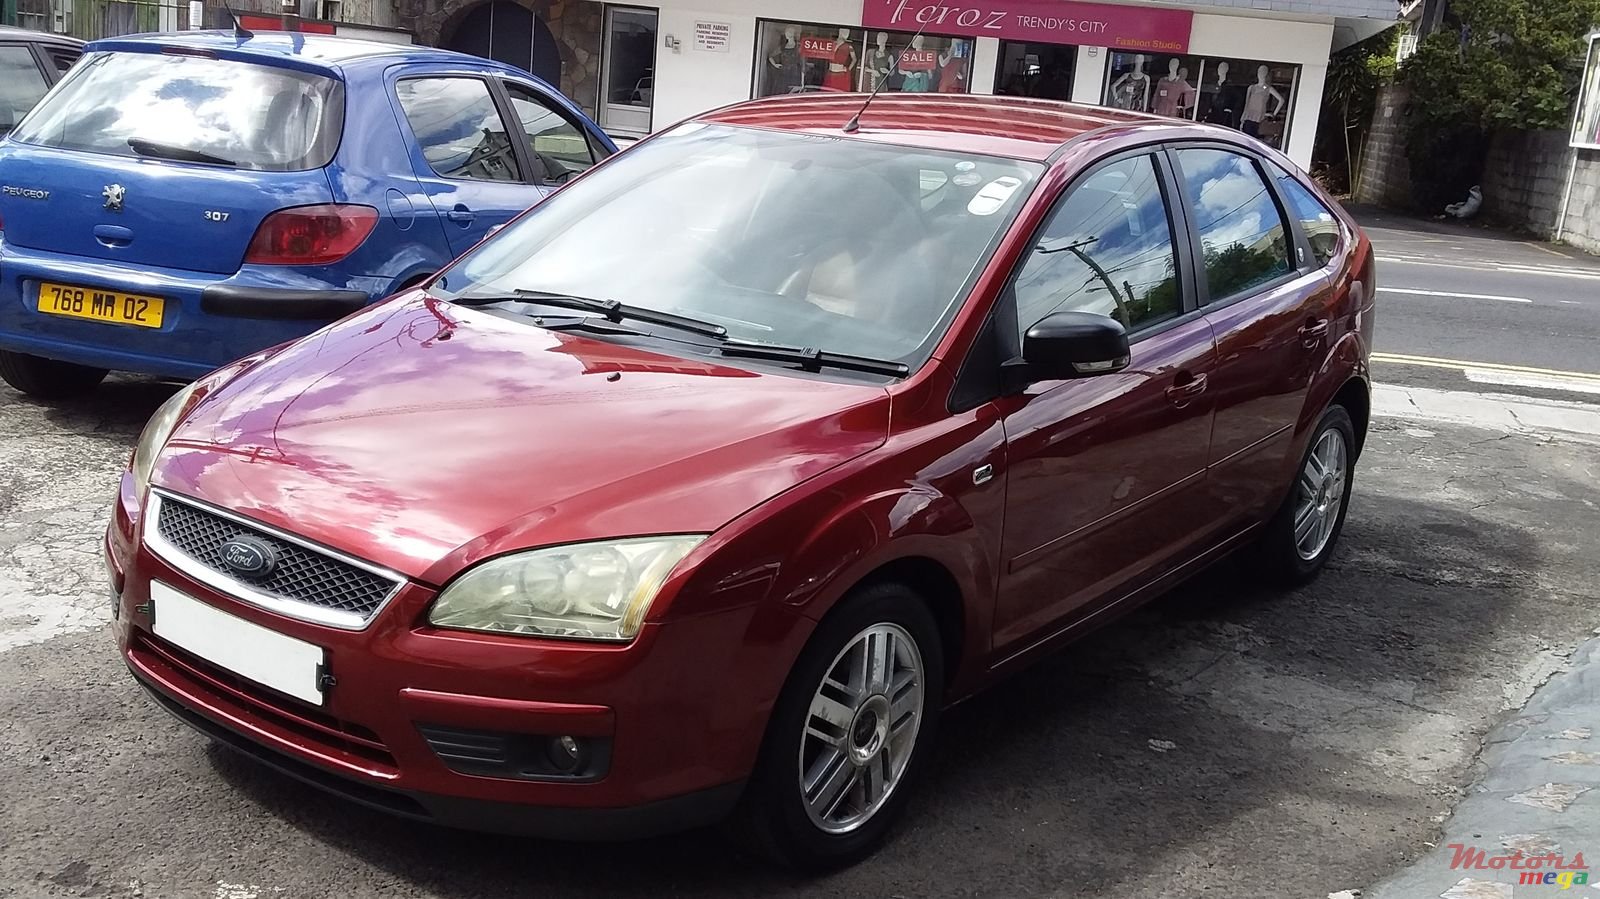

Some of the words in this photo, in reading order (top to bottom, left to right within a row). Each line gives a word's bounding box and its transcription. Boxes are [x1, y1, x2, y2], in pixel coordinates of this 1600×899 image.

[1016, 15, 1076, 31] TRENDY'S
[1079, 20, 1108, 33] CITY
[804, 40, 833, 51] SALE
[1115, 36, 1151, 47] Fashion
[1152, 39, 1182, 50] Studio
[902, 52, 934, 62] SALE
[2, 185, 50, 199] PEUGEOT
[204, 211, 230, 222] 307
[51, 287, 84, 313] 768
[123, 299, 149, 322] 02
[226, 545, 254, 567] Ford
